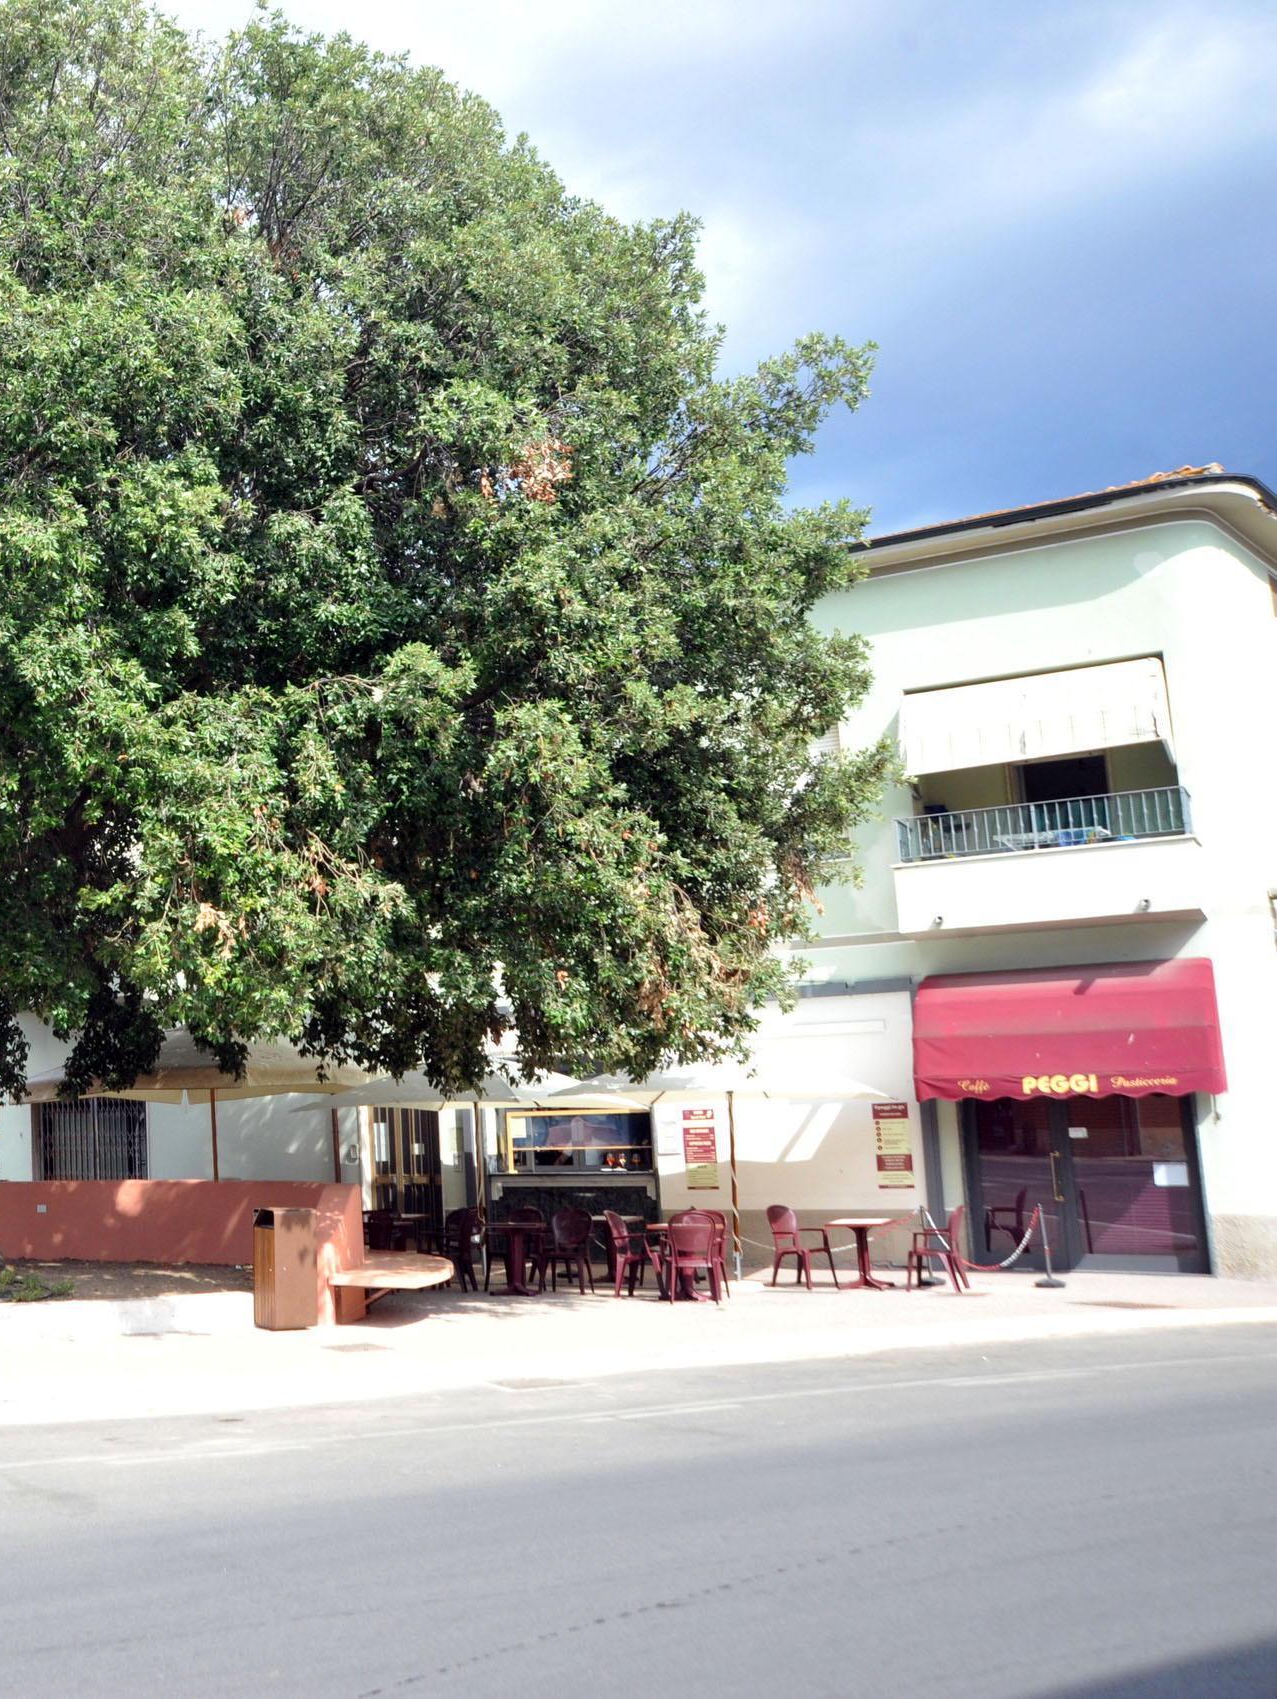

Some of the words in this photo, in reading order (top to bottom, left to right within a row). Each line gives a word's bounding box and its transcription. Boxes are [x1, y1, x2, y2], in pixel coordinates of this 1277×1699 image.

[957, 1079, 990, 1095] Caffè
[1022, 1074, 1099, 1094] PEGGI
[1110, 1075, 1178, 1089] Pasticceria
